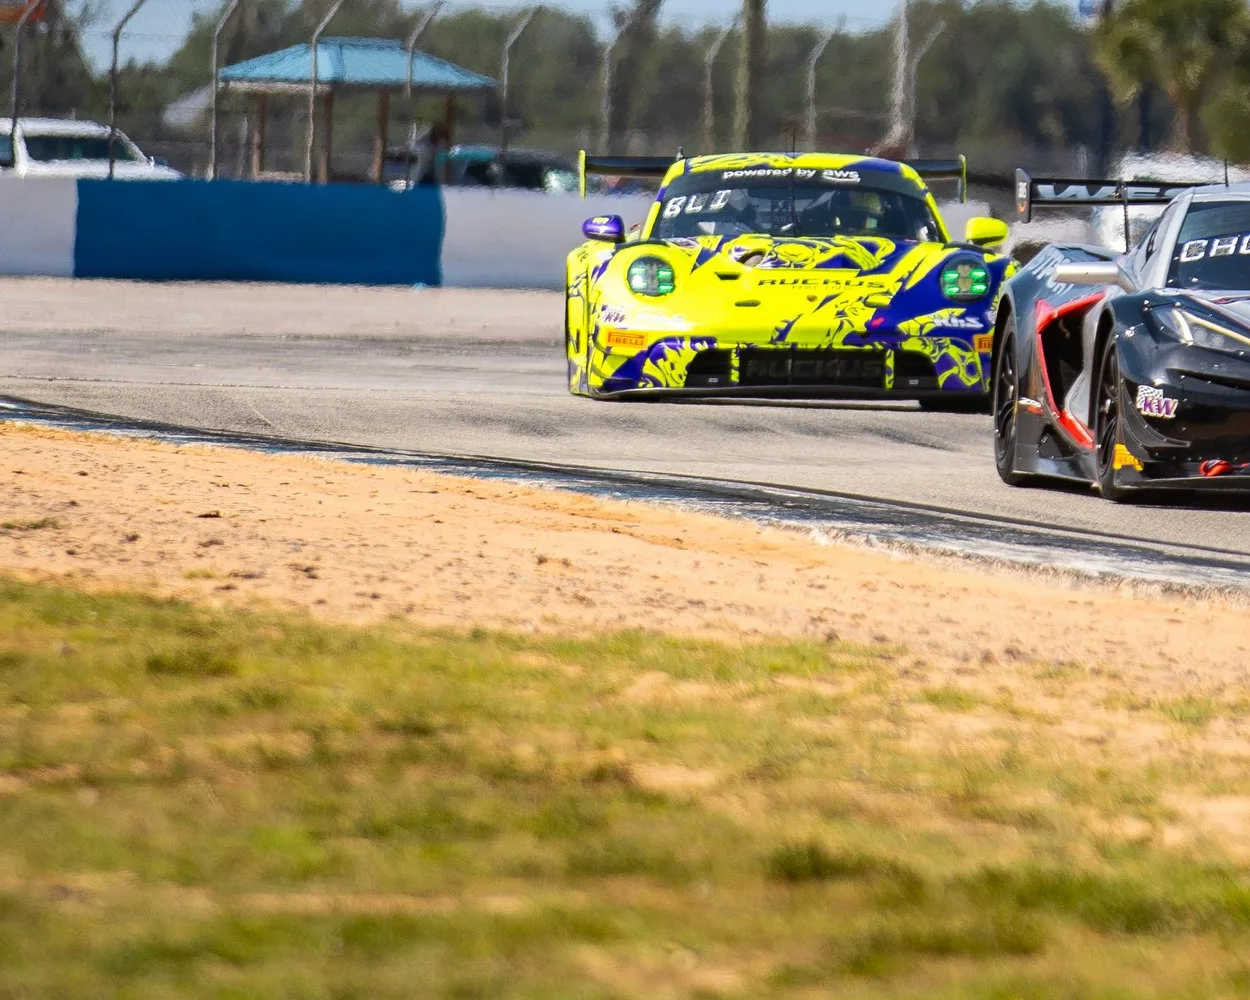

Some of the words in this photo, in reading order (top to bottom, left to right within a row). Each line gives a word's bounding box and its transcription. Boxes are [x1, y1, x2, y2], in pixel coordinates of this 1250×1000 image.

[723, 167, 792, 180] powered
[796, 168, 816, 179] by
[822, 169, 860, 181] aws
[758, 278, 885, 289] RUCKUS
[608, 331, 645, 346] PIRELLI
[1142, 397, 1179, 418] KW
